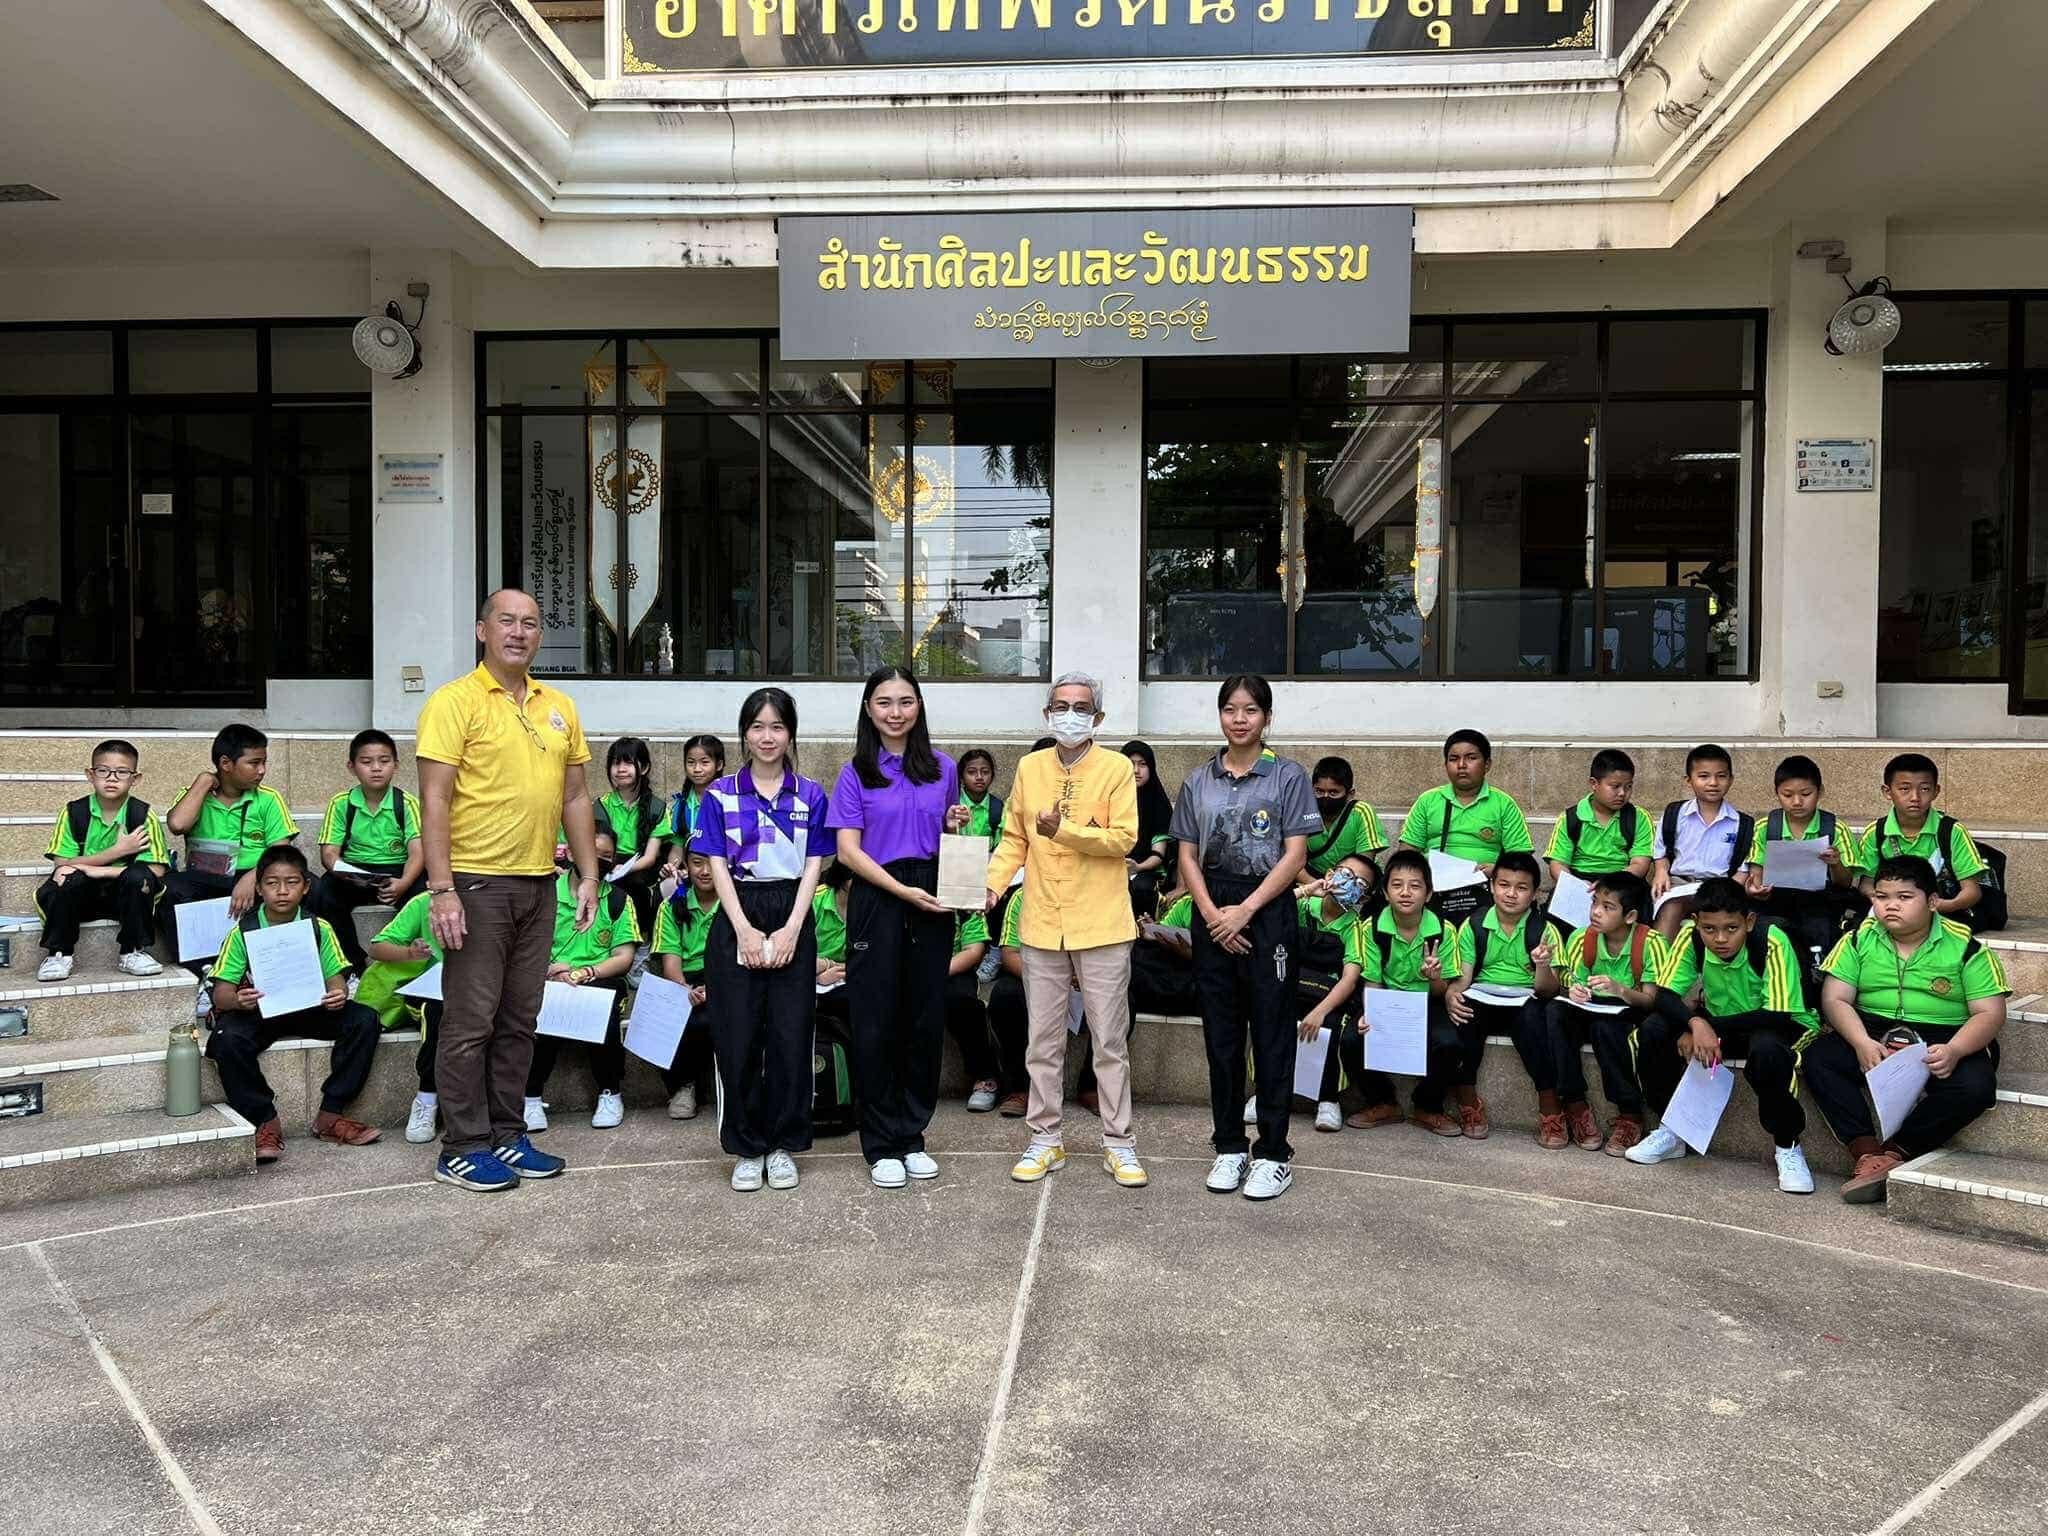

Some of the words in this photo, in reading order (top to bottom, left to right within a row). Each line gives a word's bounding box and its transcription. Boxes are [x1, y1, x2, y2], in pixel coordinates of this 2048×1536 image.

[816, 232, 1370, 290] สำนักศิลปะและวัฒนธรรม
[567, 497, 577, 523] Space
[567, 525, 577, 564] Learning
[567, 566, 576, 599] Culture
[567, 608, 576, 628] Arts
